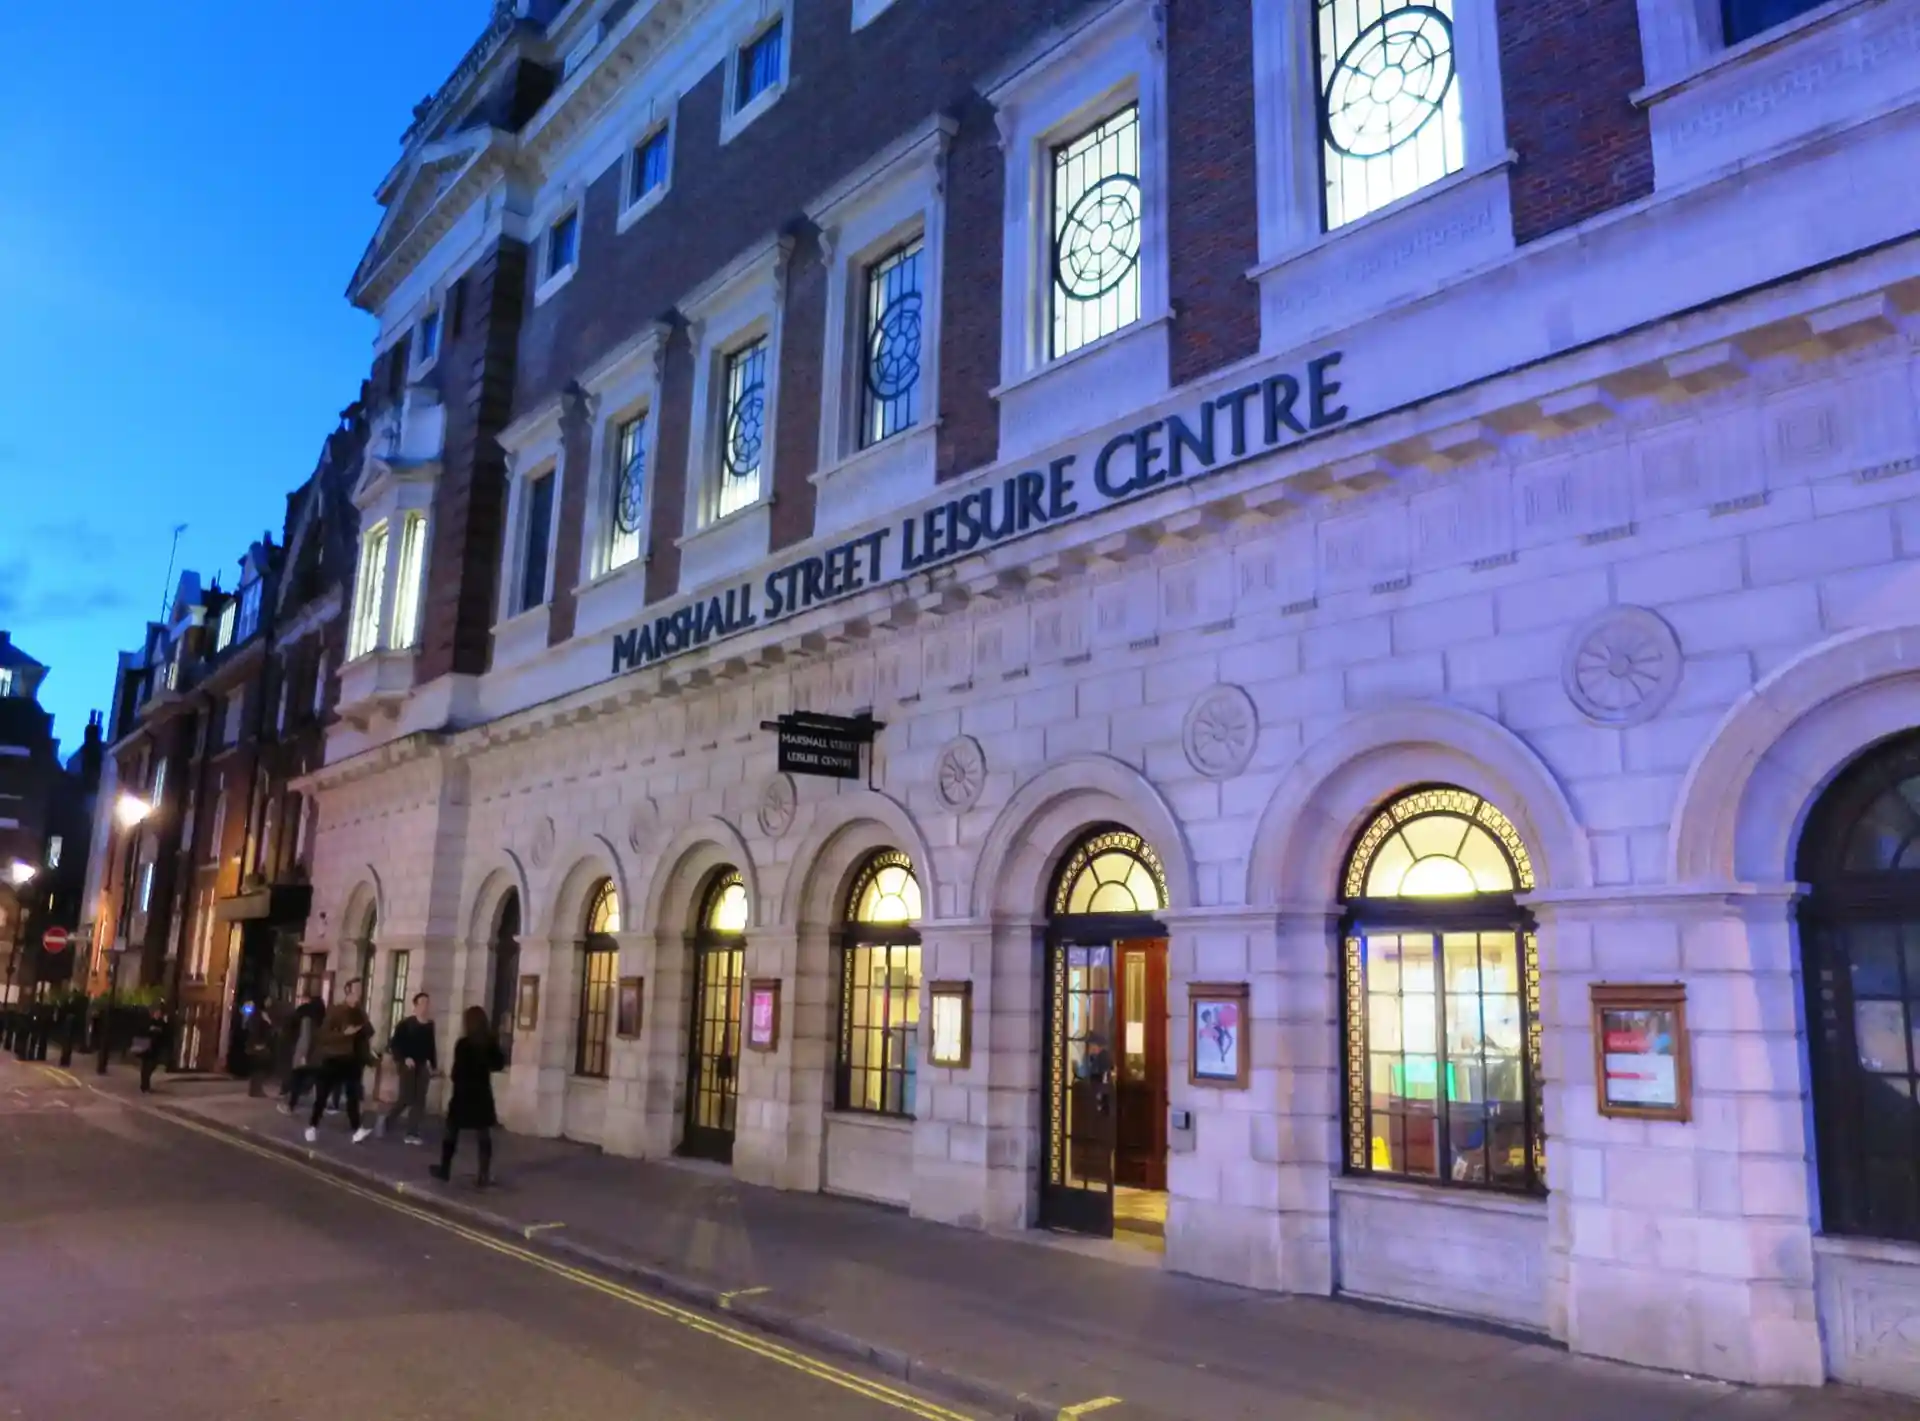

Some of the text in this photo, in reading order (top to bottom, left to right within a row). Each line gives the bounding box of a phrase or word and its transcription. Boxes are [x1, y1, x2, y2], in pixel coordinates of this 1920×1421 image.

[611, 351, 1348, 674] MARSHALL STREET LEISURE CENTRE
[781, 733, 828, 748] MARSHALL
[821, 755, 852, 769] CEN
